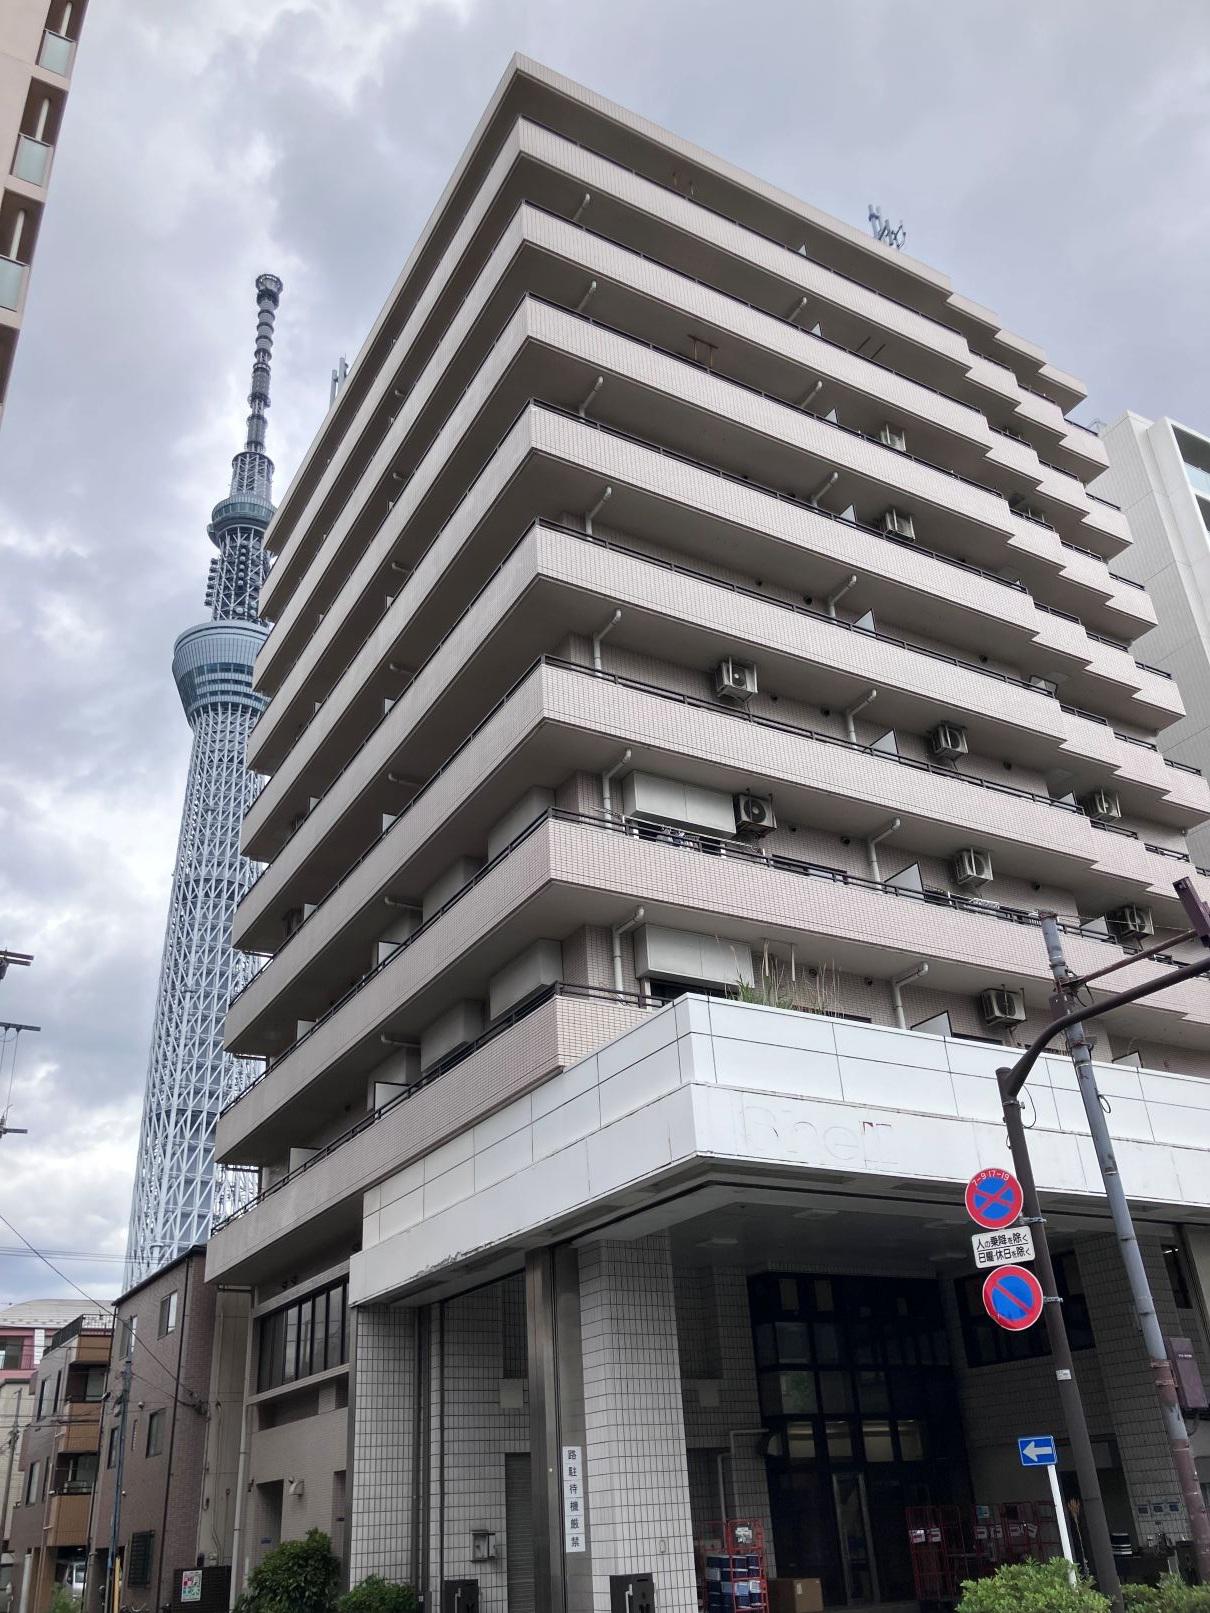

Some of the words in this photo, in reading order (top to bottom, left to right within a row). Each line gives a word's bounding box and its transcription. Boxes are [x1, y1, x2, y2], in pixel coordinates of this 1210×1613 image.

[976, 1232, 1028, 1251] 人の乗降を除く
